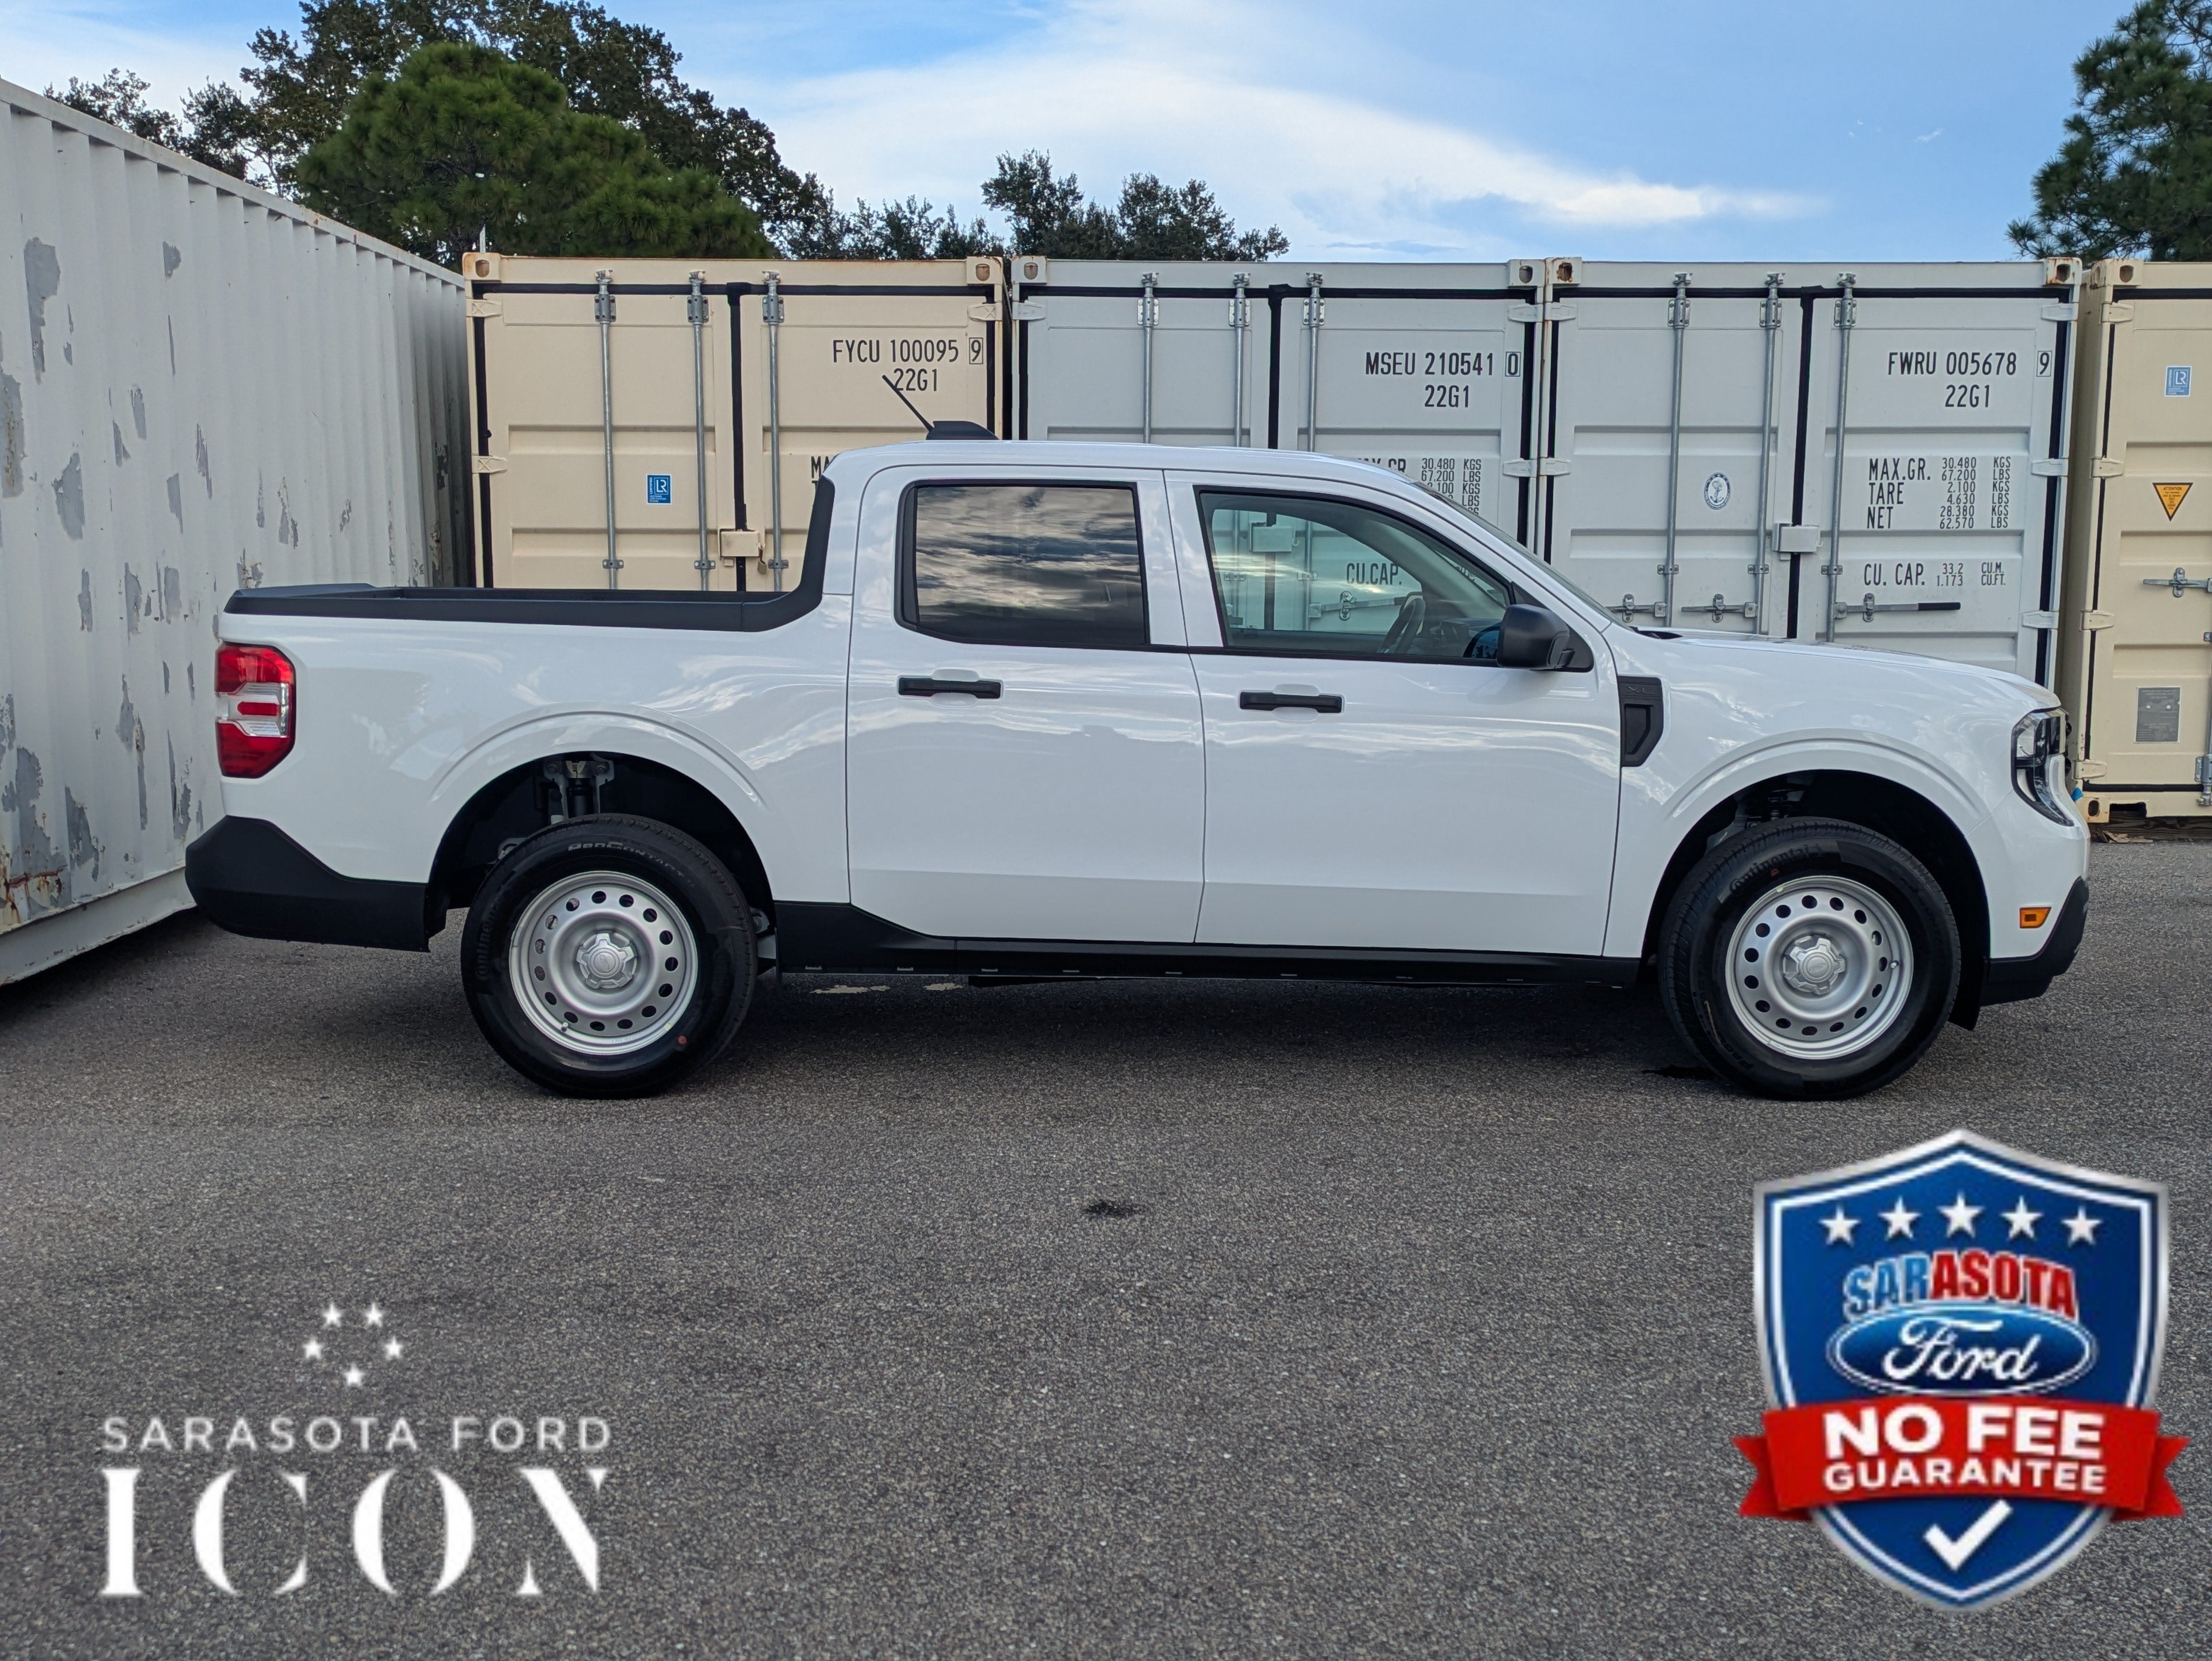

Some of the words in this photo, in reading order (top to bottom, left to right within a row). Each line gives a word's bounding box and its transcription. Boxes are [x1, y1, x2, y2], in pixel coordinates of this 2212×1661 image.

[833, 340, 880, 363] FYCU
[890, 339, 959, 362] 100095
[971, 339, 982, 363] 9
[1366, 352, 1416, 375] MSEU
[1425, 352, 1493, 376] 210541
[1507, 353, 1519, 376] 0
[1888, 352, 1937, 375] FWRU
[1946, 352, 2016, 376] 005678
[2039, 352, 2050, 375] 9
[893, 368, 937, 391] 22G1
[1424, 385, 1469, 408] 22G1
[1945, 385, 1990, 408] 22G1
[1464, 458, 1482, 470] KGS
[1994, 456, 2011, 468] KGS
[1869, 457, 1931, 481] MAX.GR.
[1993, 469, 2010, 480] LBS
[1463, 471, 1481, 482] LBS
[1462, 483, 1481, 495] KGS
[1992, 481, 2010, 492] KGS
[1869, 482, 1904, 505] TARE
[1992, 493, 2010, 504] LBS
[1462, 495, 1480, 507] LBS
[1991, 505, 2009, 516] KGS
[1867, 506, 1894, 529] NET
[1991, 517, 2008, 529] LBS
[1347, 563, 1402, 585] CU.CAP.
[1895, 563, 1925, 586] CAP.
[1942, 563, 1963, 574] 33.2
[1627, 686, 1656, 695] XL
